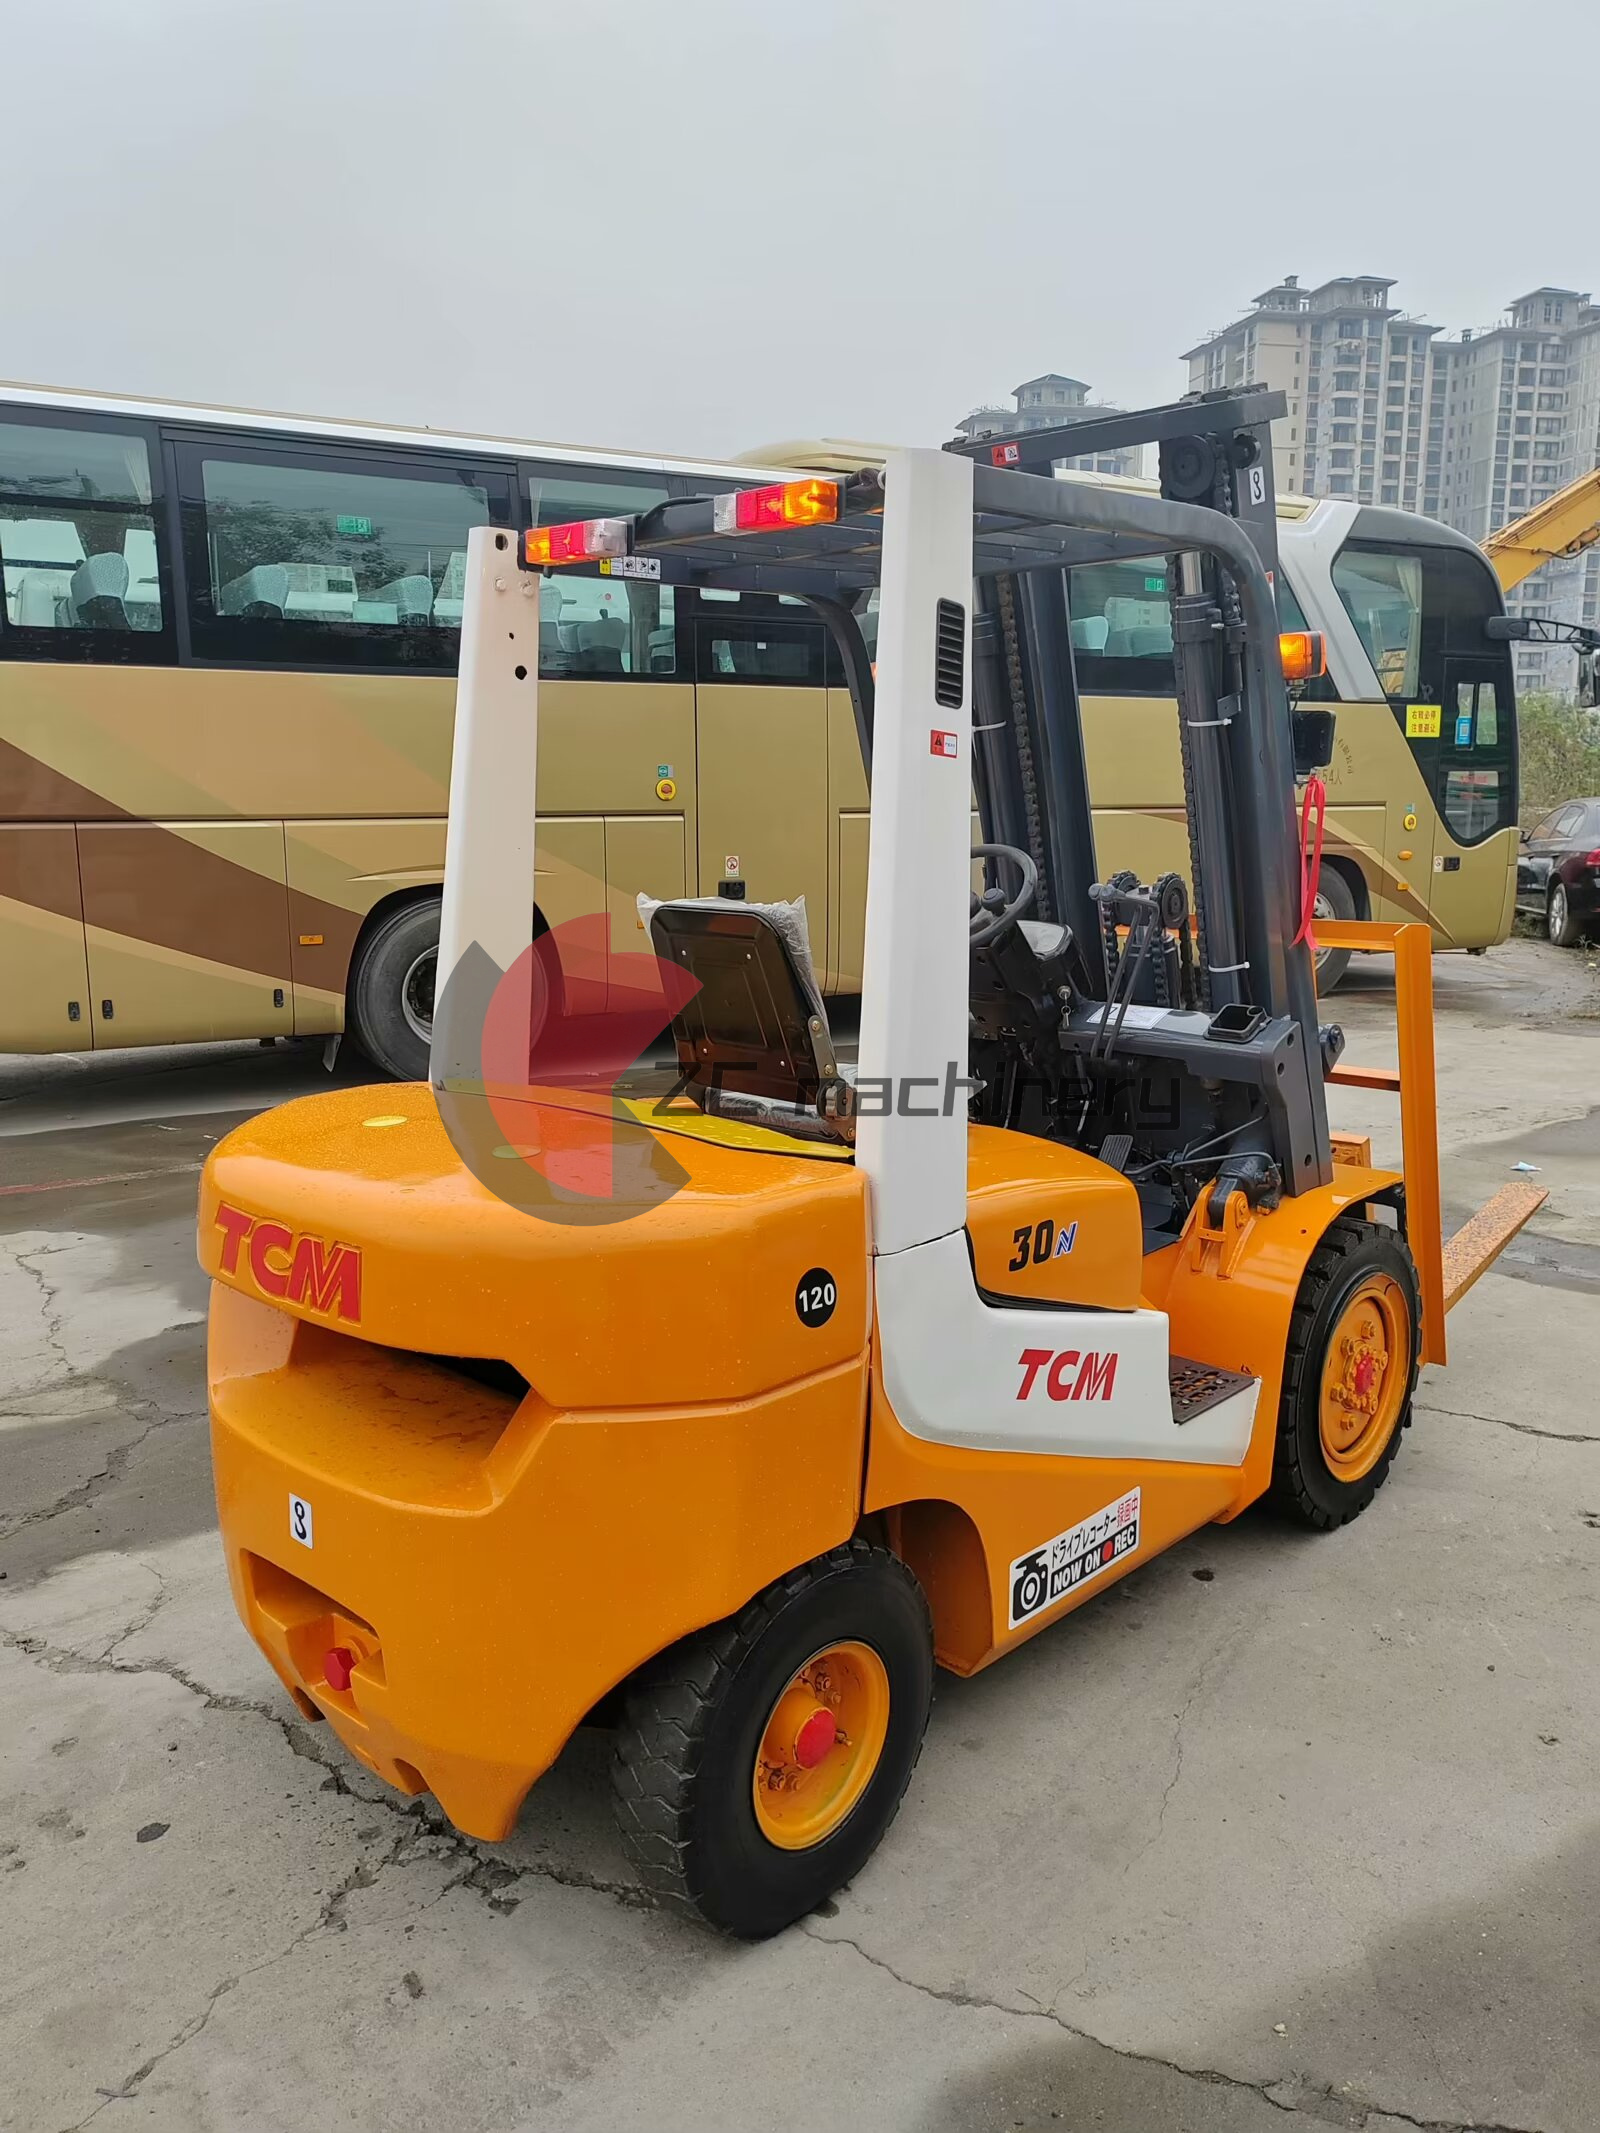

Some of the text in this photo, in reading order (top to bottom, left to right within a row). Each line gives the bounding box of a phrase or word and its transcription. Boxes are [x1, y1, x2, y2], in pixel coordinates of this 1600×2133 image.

[215, 1202, 362, 1326] TCM
[799, 1283, 835, 1312] 120
[1016, 1349, 1118, 1401] TCM
[1053, 1525, 1135, 1595] NOW ON REC
